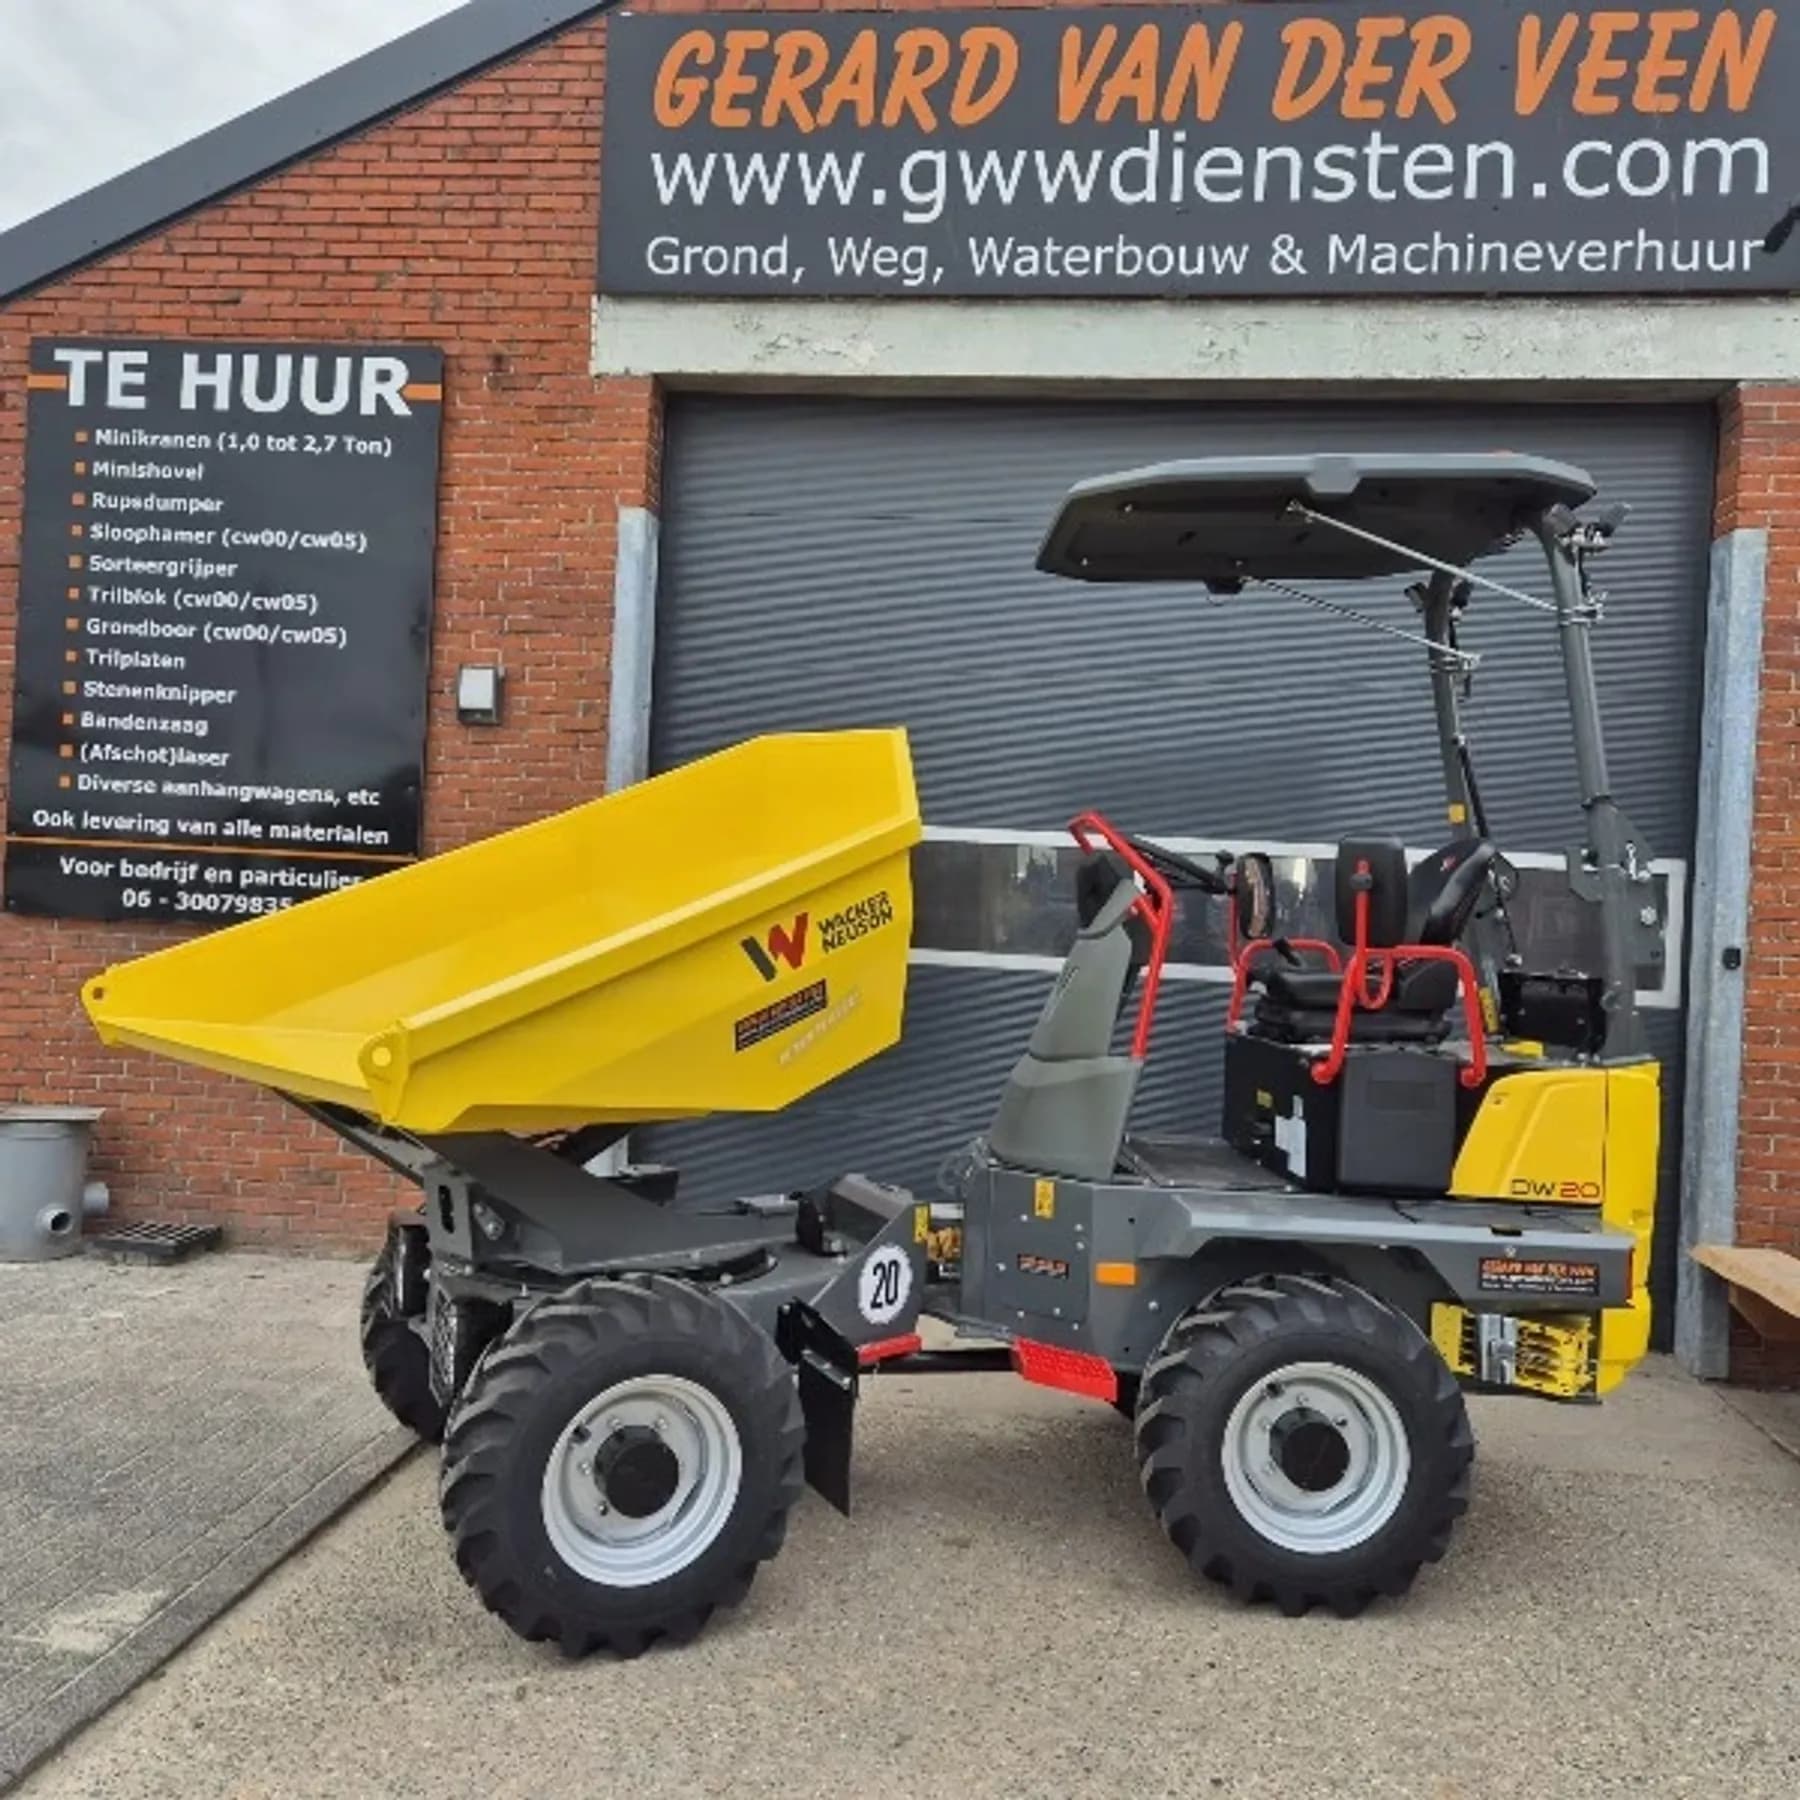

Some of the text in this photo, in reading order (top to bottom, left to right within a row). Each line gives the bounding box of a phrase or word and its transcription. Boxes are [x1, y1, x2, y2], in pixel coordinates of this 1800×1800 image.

[653, 8, 1777, 133] GERARD VAN DER VEEN
[650, 129, 1770, 223] www.gwwdiensten.com
[646, 228, 1766, 285] Grond, Weg, Waterbouw & Machineverhuur
[53, 348, 413, 417] TE HUUR
[95, 428, 393, 457] Minikranen (1,0 tot 2,7 Ton)
[92, 460, 205, 481] Minishovel
[91, 491, 225, 516] Rupsdumper
[88, 522, 369, 554] Sloophamer (cw00/cw05)
[88, 554, 239, 579] Sorteergrijper
[87, 585, 319, 616] Trilblok (cw00/cw05)
[86, 617, 348, 649] Grondboor (cw00/cw05)
[86, 648, 186, 672] Trilplaten
[83, 680, 238, 706] Stenenknipper
[80, 711, 209, 736] Bandenzaag
[80, 742, 231, 768] (Afschot)laser
[77, 773, 381, 808] Diverse aanhangwagens, etc
[32, 808, 390, 846] Ook levering van alle materialen
[59, 856, 116, 876] Voor
[119, 857, 201, 885] bedrijf
[204, 864, 233, 884] en
[122, 890, 152, 908] 06
[818, 891, 889, 935] WACKER
[821, 906, 894, 955] NEUSON
[870, 1259, 900, 1309] 20
